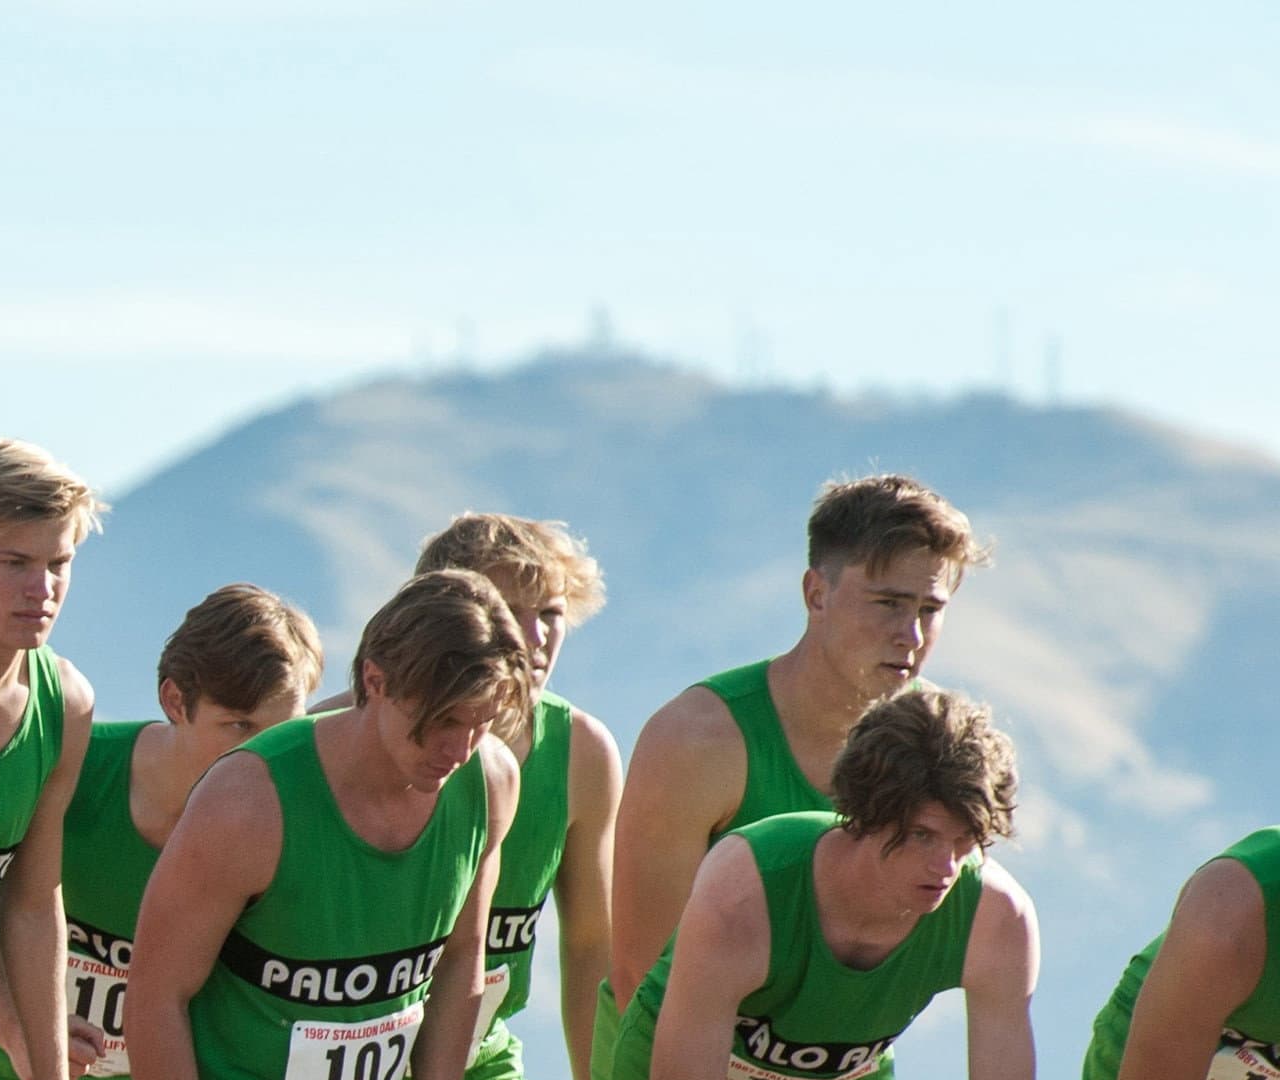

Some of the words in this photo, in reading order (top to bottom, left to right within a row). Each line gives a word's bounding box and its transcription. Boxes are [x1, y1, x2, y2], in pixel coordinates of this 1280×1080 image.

[261, 959, 378, 1001] PALO
[387, 944, 444, 994] ALT
[75, 975, 128, 1037] 10
[304, 1027, 331, 1040] 1987
[332, 1024, 378, 1041] STALLION
